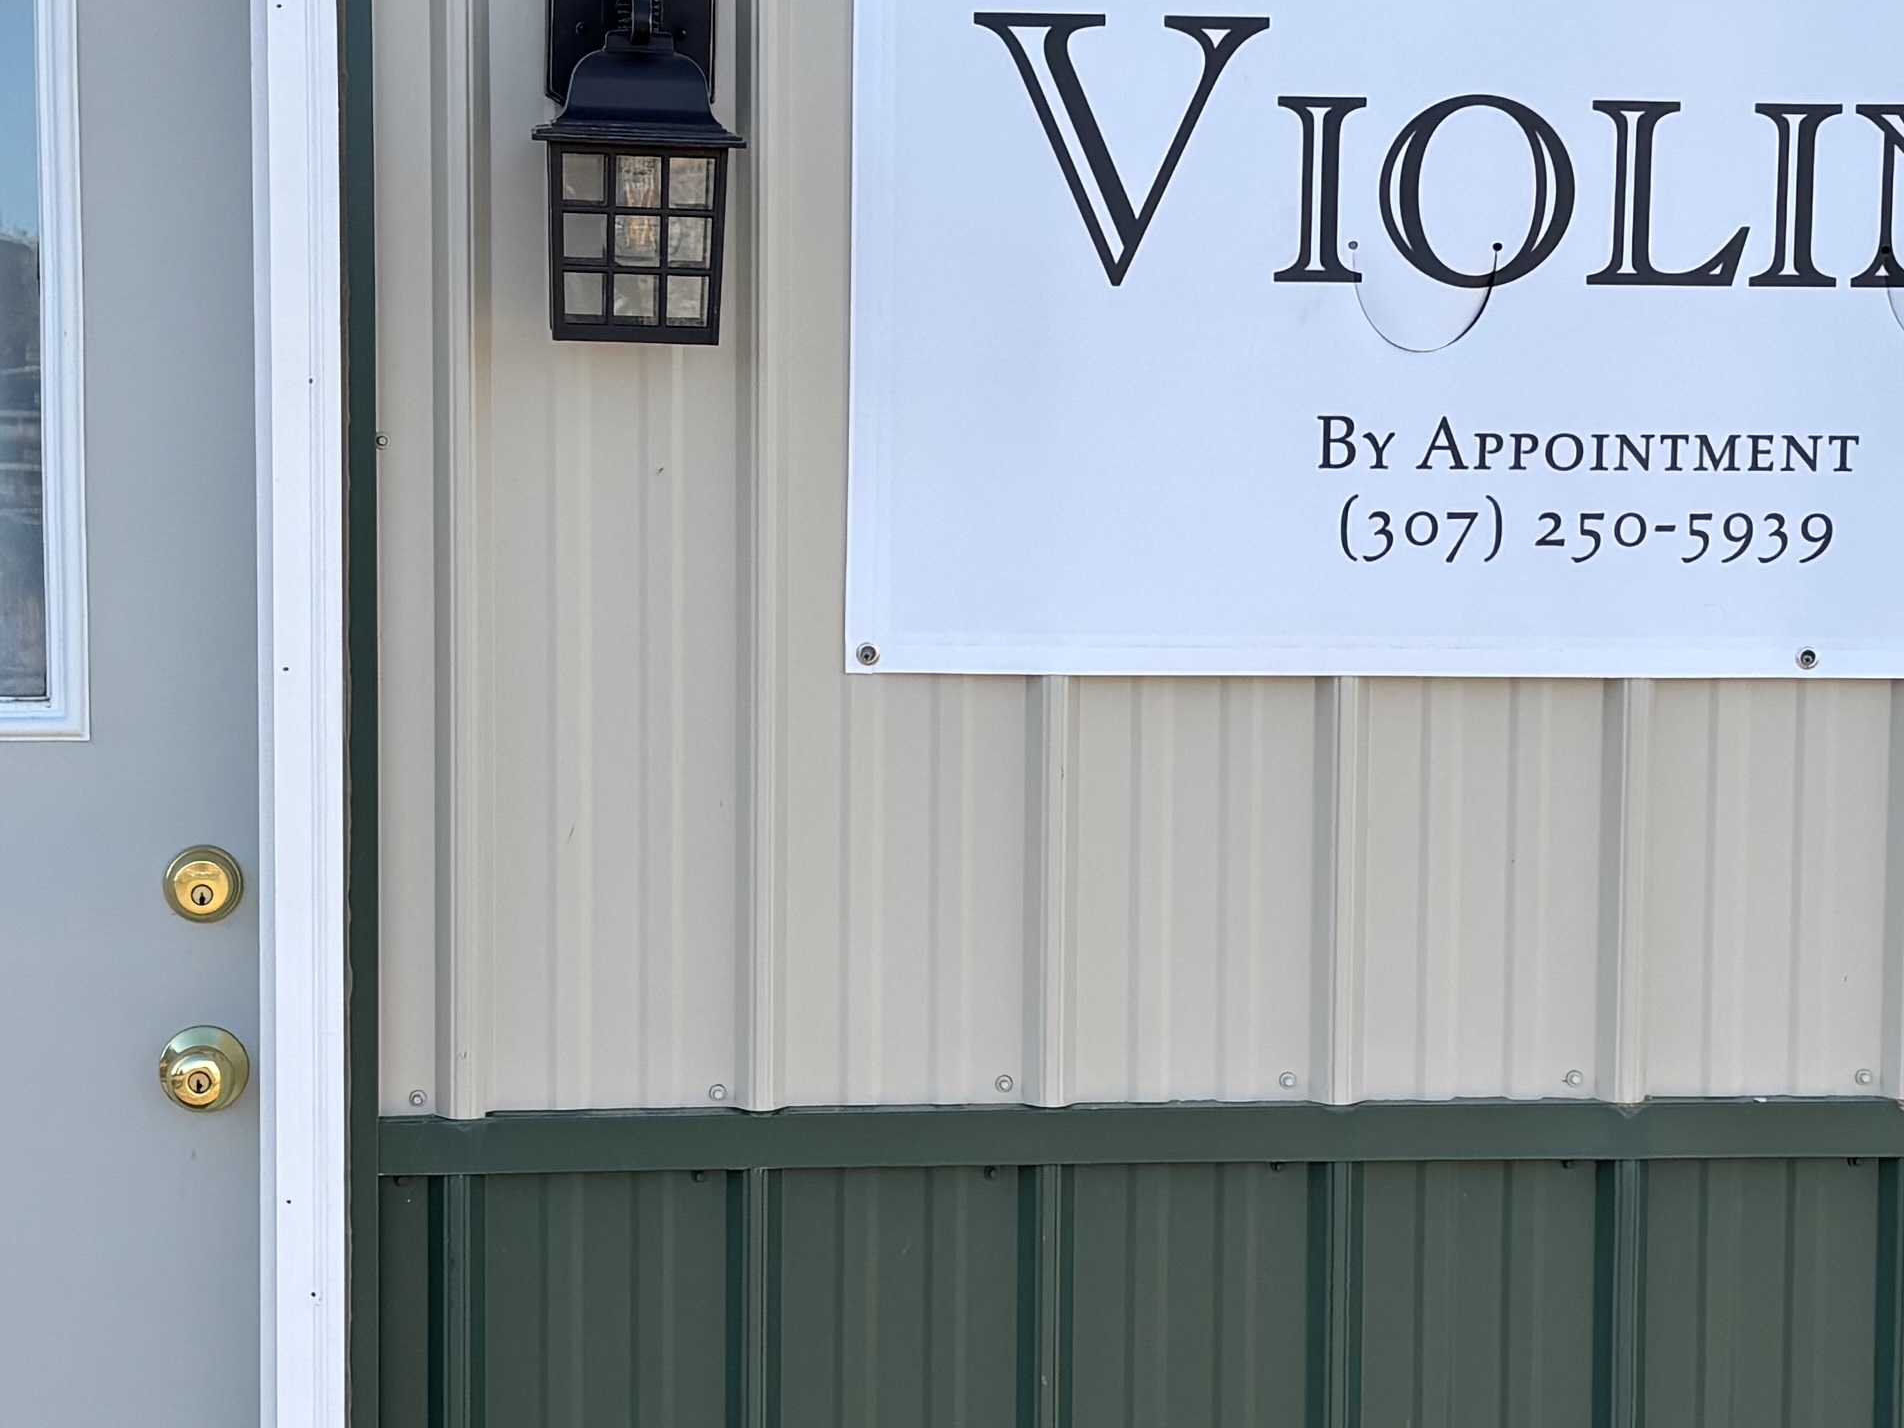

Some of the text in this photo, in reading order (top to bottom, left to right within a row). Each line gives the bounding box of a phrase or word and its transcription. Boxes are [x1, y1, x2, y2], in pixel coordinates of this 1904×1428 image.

[1316, 414, 1861, 473] BY APPOINTMENT
[1339, 493, 1834, 565] (307) 250-5939
